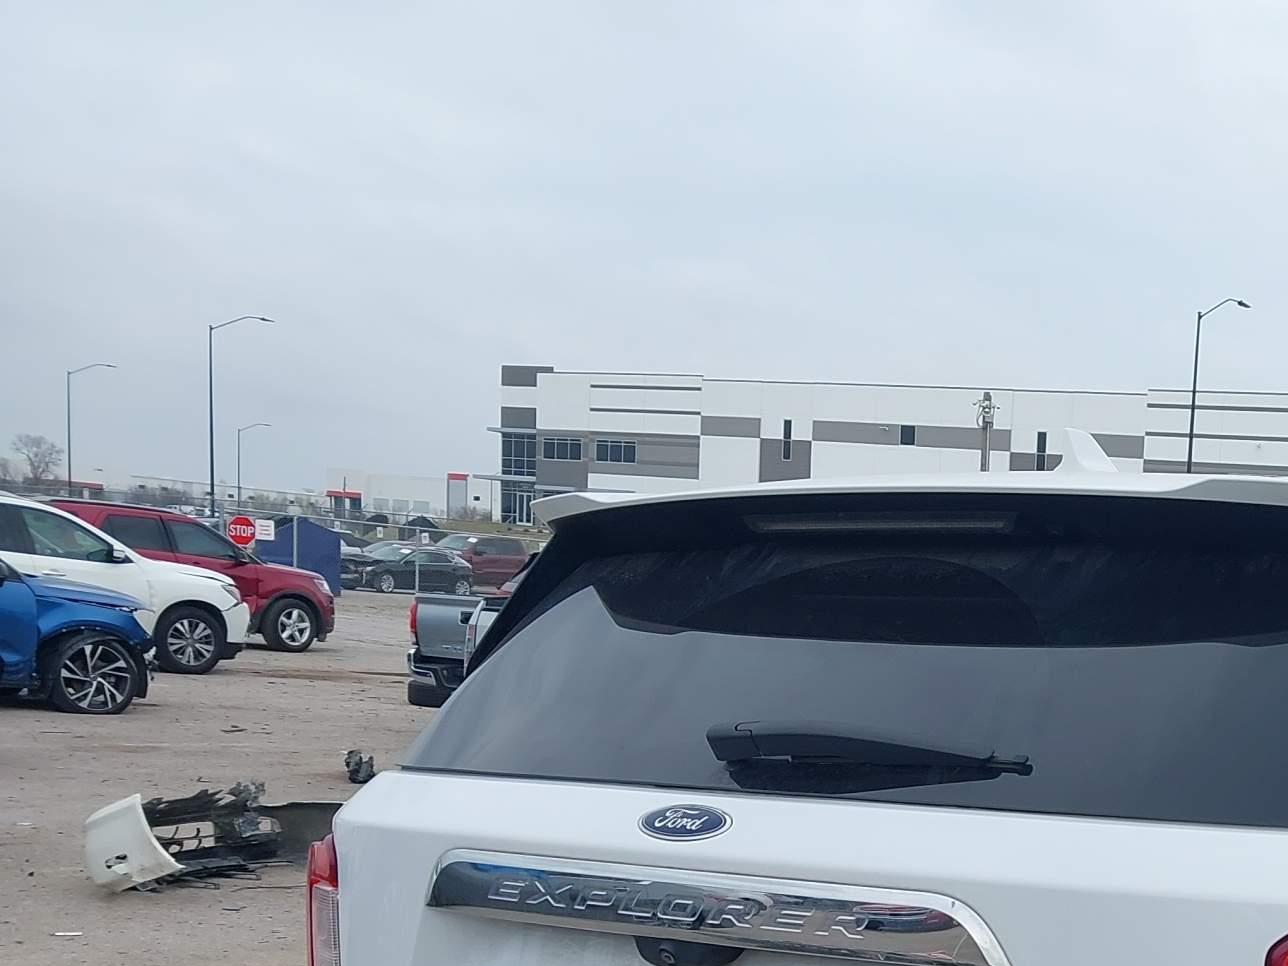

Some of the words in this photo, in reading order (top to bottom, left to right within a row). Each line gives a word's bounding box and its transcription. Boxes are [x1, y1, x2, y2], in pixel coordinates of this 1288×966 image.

[229, 524, 255, 537] STOP
[654, 808, 709, 830] Ford
[487, 879, 869, 939] EXPLORER
